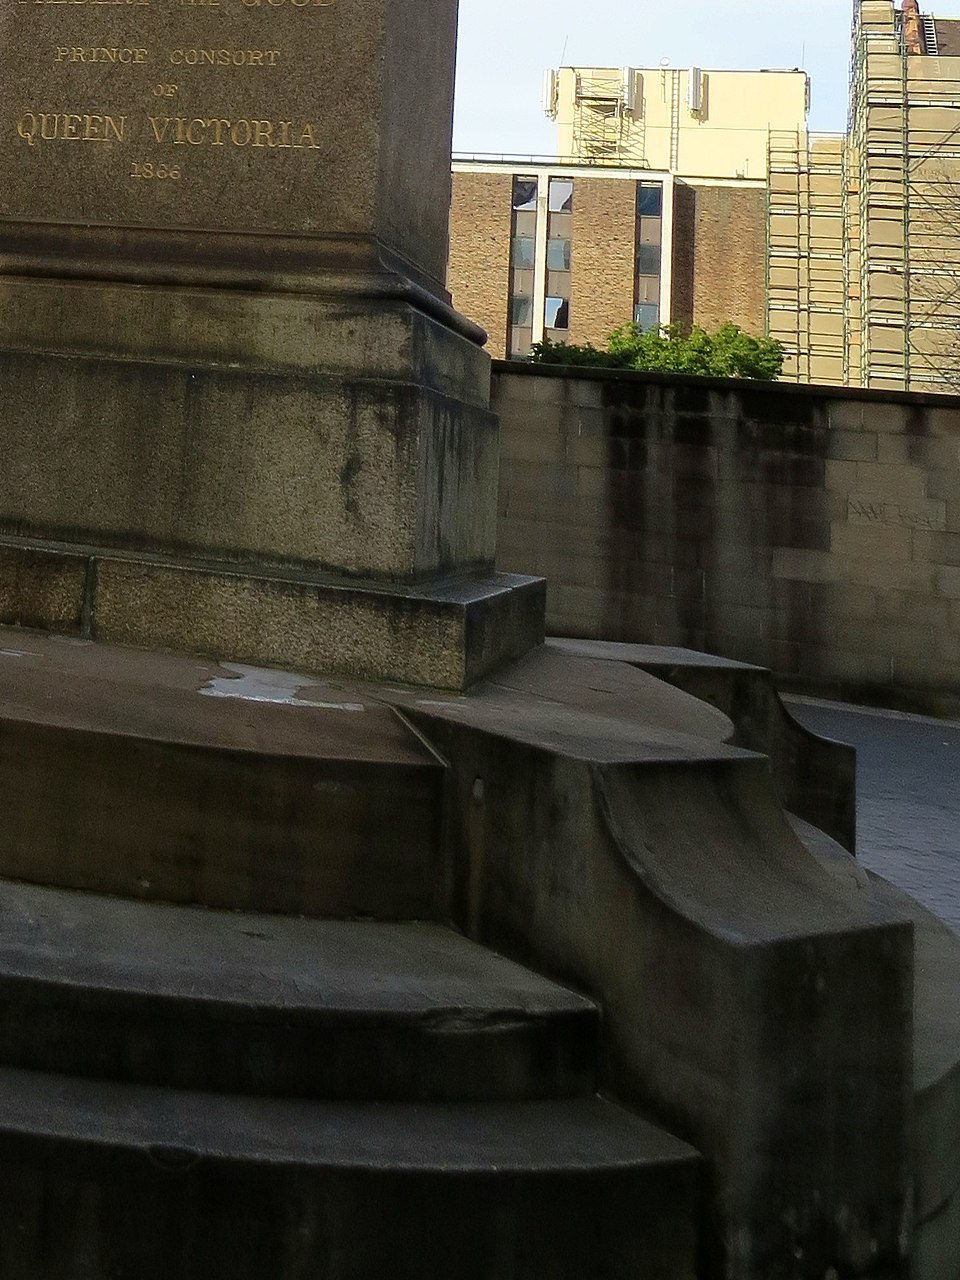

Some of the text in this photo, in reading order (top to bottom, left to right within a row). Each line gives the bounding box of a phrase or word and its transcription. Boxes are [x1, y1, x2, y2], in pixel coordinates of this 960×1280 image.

[54, 46, 281, 67] PRINCE CONSORT
[153, 83, 178, 98] OF
[16, 113, 321, 149] QUEEN VICTORIA
[130, 162, 181, 180] 1866
